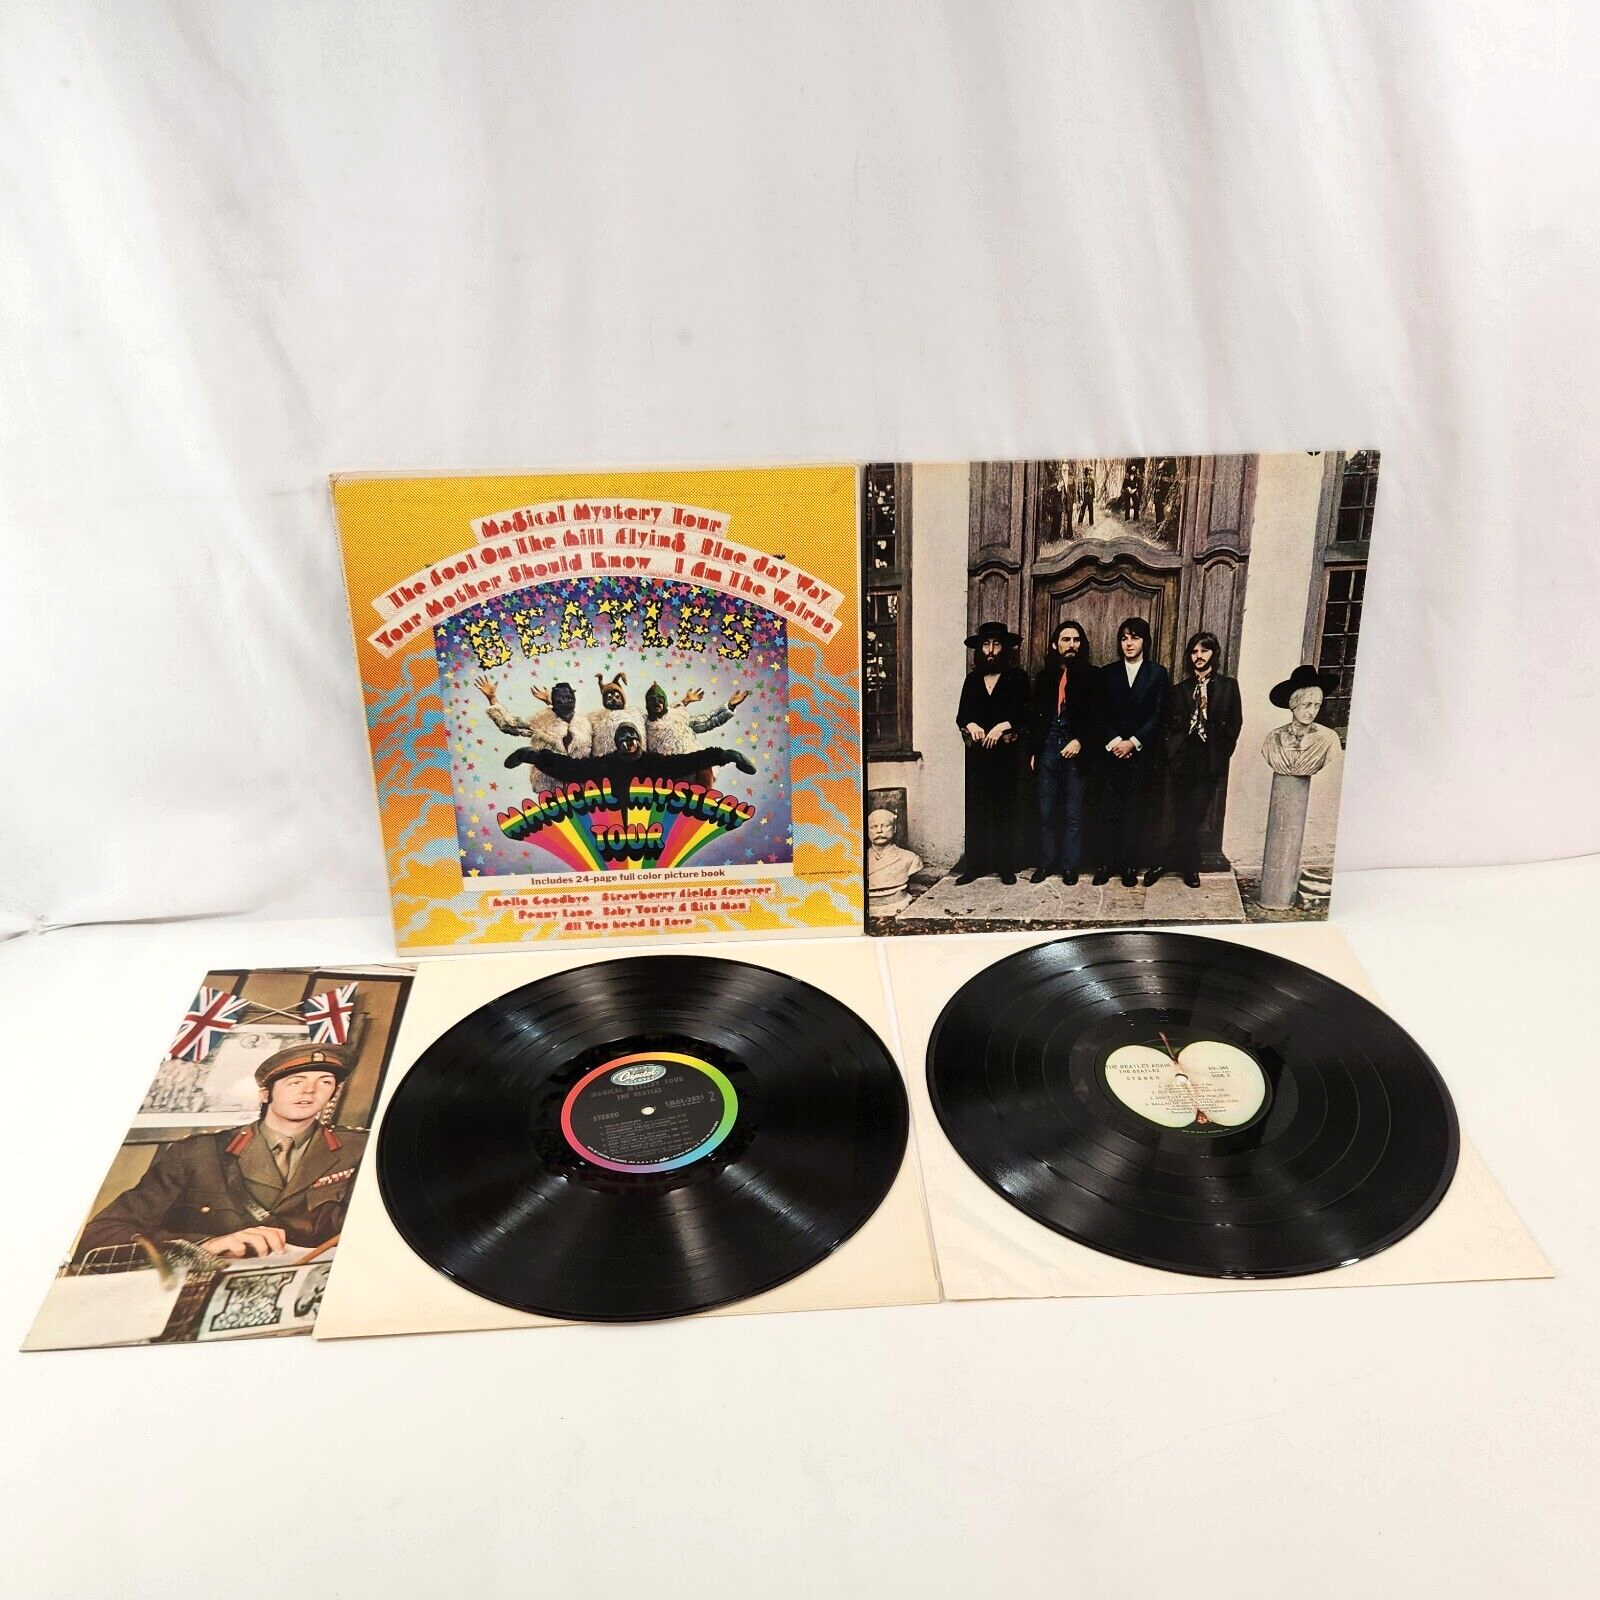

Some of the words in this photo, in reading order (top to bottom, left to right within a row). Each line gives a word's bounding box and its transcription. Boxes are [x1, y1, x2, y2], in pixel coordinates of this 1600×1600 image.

[481, 505, 566, 538] Magical
[573, 503, 662, 524] Mystery
[671, 506, 722, 532] Tour
[386, 581, 427, 610] The
[480, 547, 512, 565] On
[513, 535, 556, 554] The
[700, 537, 747, 565] Blue
[797, 573, 832, 605] Way
[375, 612, 422, 648] Your
[425, 575, 502, 618] Mother
[507, 553, 583, 583] Should
[591, 552, 651, 569] Know
[674, 557, 685, 574] I
[691, 561, 722, 583] Am
[729, 569, 767, 597] The
[773, 588, 834, 634] Walrus
[463, 599, 756, 671] BEATLES
[496, 777, 619, 840] MAGICAL
[628, 776, 755, 831] MYSTERY
[590, 823, 666, 857] TOUR
[531, 876, 573, 885] Includes
[575, 874, 617, 884] 24-page
[619, 872, 635, 881] full
[637, 871, 662, 881] color
[664, 870, 699, 880] picture
[701, 869, 725, 878] book
[519, 909, 558, 920] Penny
[562, 908, 593, 918] Lane
[602, 906, 632, 918] Baby
[635, 904, 674, 914] You're
[690, 902, 717, 912] Rich
[720, 901, 746, 910] Man
[532, 894, 590, 906] Goodbye
[602, 890, 676, 902] Strawberry
[564, 921, 581, 931] All
[586, 921, 609, 930] You
[664, 917, 692, 927] Love
[708, 1090, 716, 1102] 2
[592, 1111, 620, 1122] STEREO
